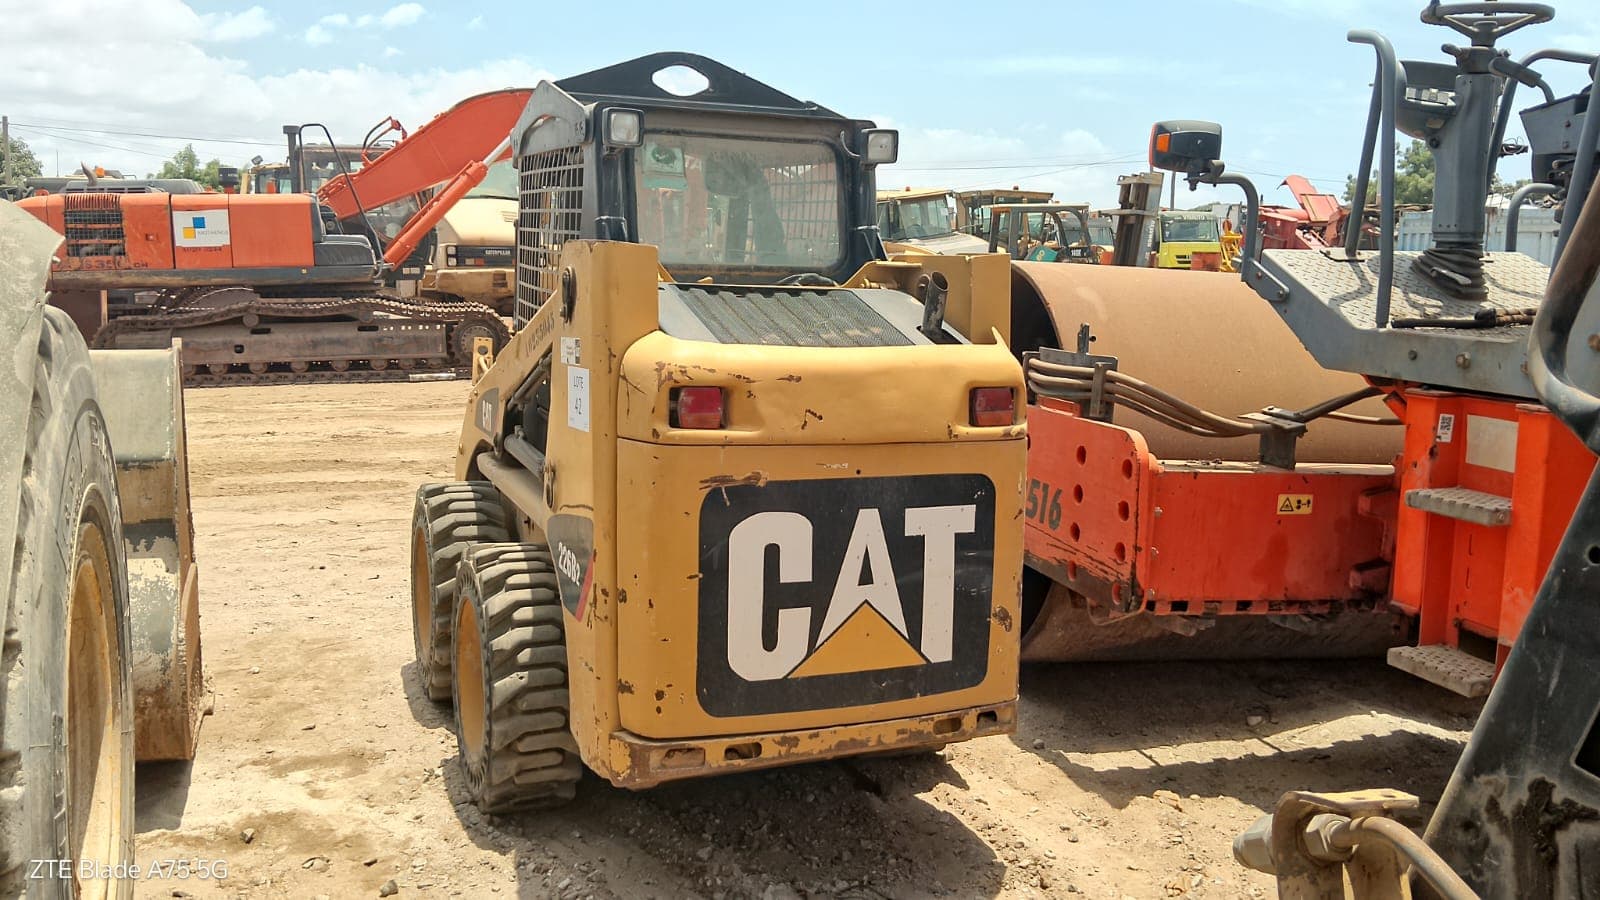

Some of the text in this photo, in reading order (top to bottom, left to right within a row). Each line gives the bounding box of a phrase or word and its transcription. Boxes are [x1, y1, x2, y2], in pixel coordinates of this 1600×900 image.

[482, 399, 492, 433] CAT
[558, 541, 581, 586] 226B2
[727, 504, 976, 682] CAT
